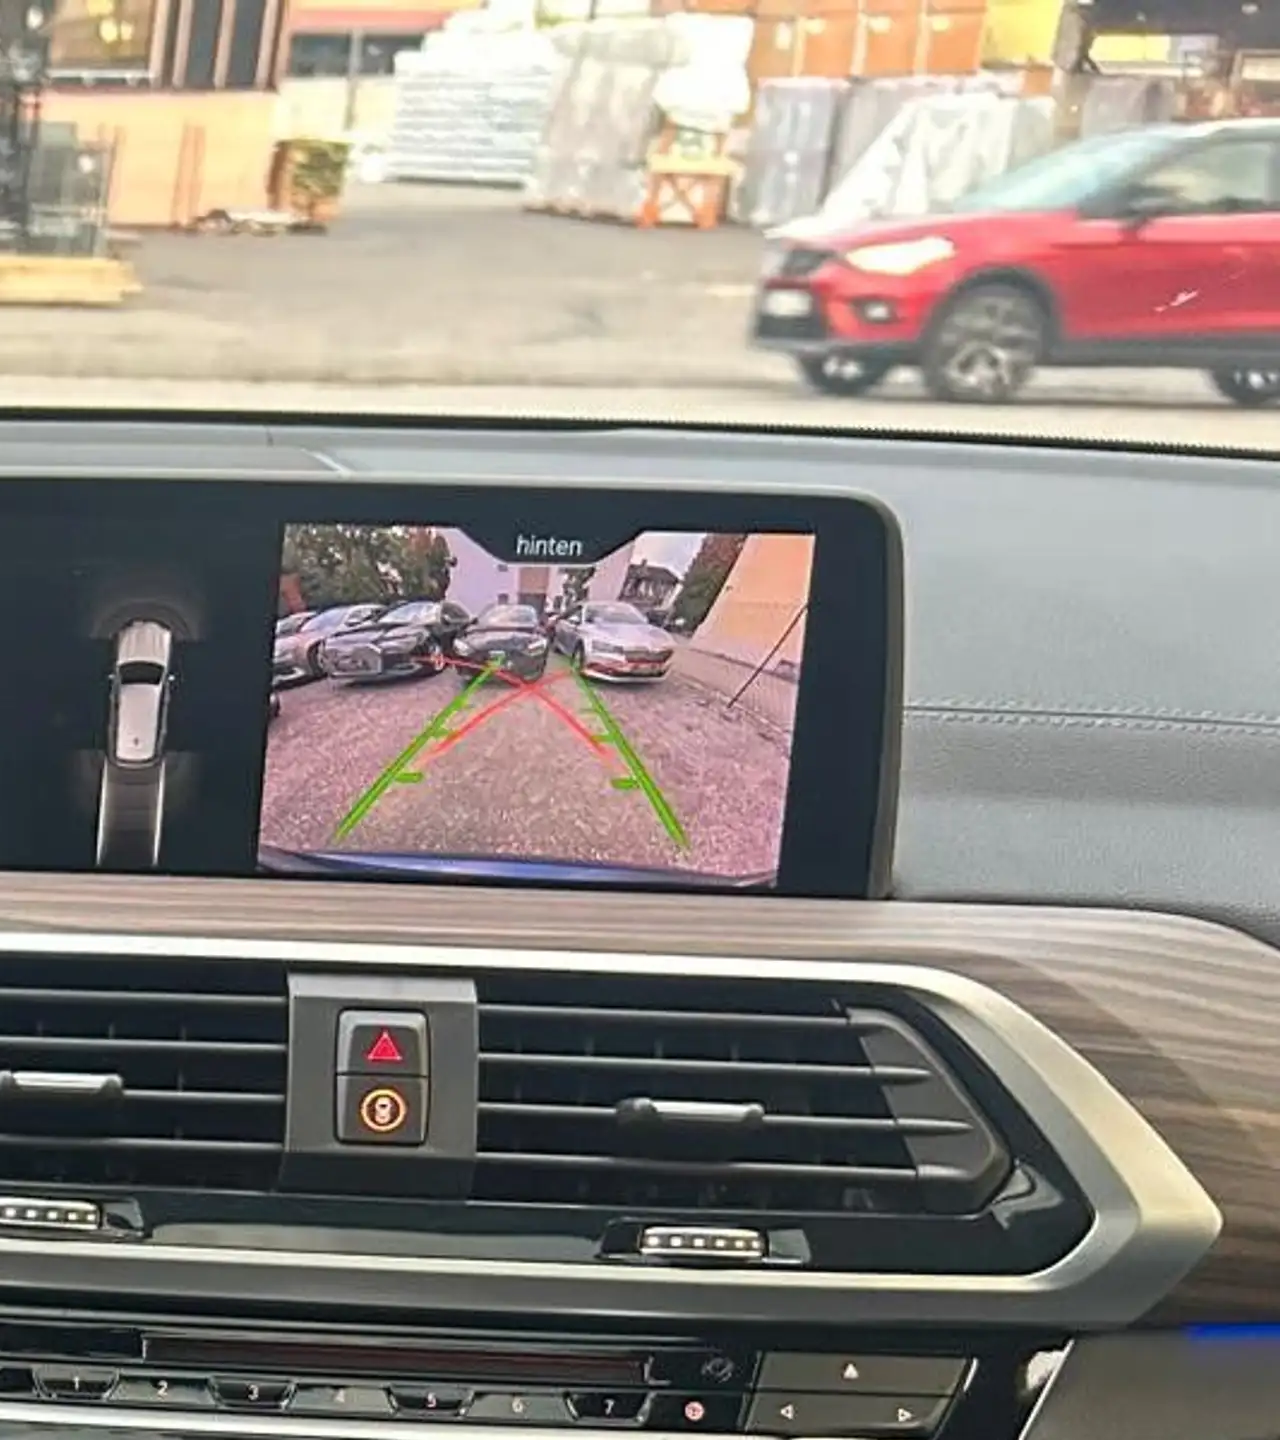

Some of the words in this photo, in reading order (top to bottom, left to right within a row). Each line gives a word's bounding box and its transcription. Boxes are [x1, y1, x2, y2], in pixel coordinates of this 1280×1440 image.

[516, 533, 583, 557] hinten
[71, 1375, 80, 1391] 1
[156, 1379, 169, 1398] 2
[247, 1384, 260, 1401] 3
[604, 1398, 615, 1415] 7
